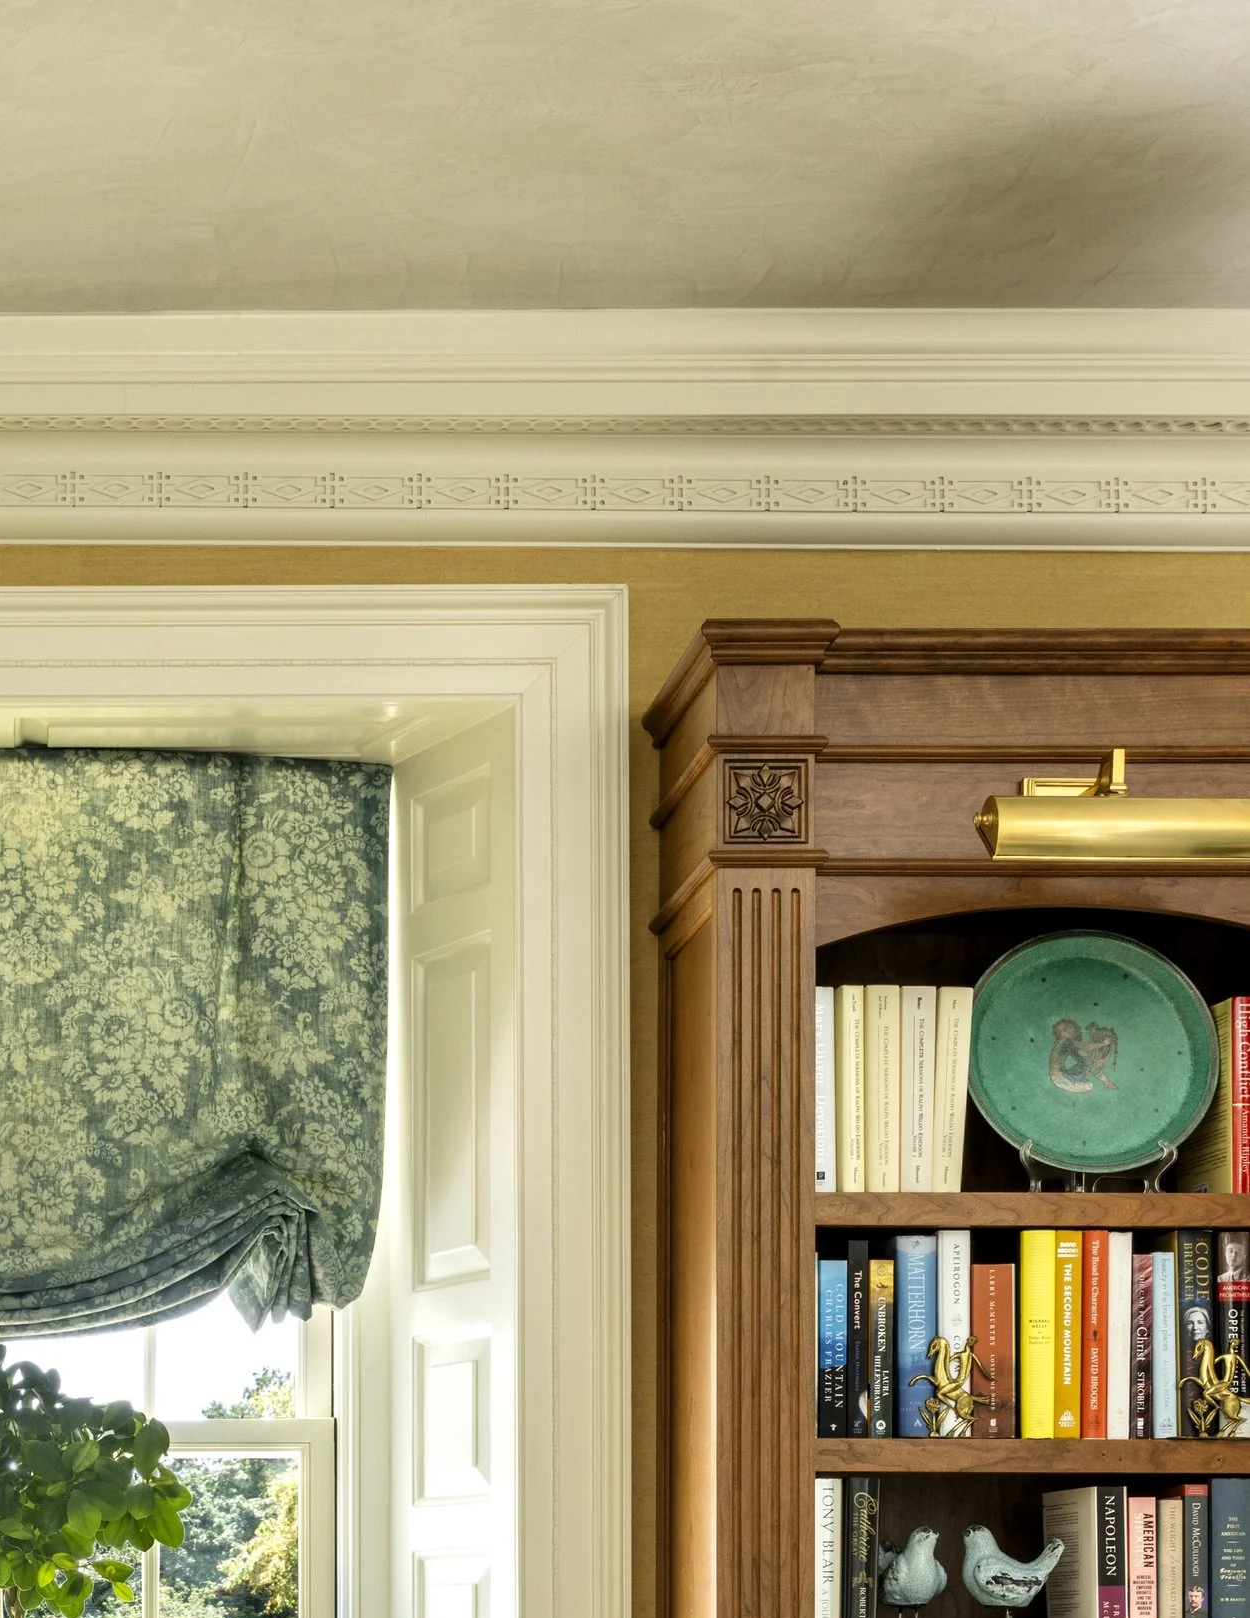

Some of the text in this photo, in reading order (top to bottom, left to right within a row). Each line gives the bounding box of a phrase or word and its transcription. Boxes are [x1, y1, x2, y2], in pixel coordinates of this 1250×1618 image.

[1091, 1240, 1100, 1255] The
[1092, 1255, 1100, 1275] Road
[1183, 1242, 1194, 1302] BREAKER
[1195, 1242, 1210, 1301] CODE
[853, 1270, 863, 1330] The Convert
[907, 1253, 927, 1351] MATTERHORN
[1092, 1278, 1098, 1286] to
[824, 1289, 833, 1403] CHARLES FRAZIER
[834, 1283, 844, 1409] COLD MOUNTAIN
[877, 1296, 886, 1353] UNBROKEN
[1063, 1263, 1073, 1385] THE SECOND MOUNTAIN
[1136, 1326, 1148, 1361] Christ
[873, 1355, 881, 1412] HILLENBRAND
[882, 1370, 890, 1397] LAURA
[1090, 1347, 1099, 1375] DAVID
[1090, 1376, 1098, 1411] BROOKS
[1136, 1371, 1145, 1414] STROBEL
[1104, 1495, 1117, 1576] NAPOLEON
[1142, 1513, 1155, 1568] AMERICAN
